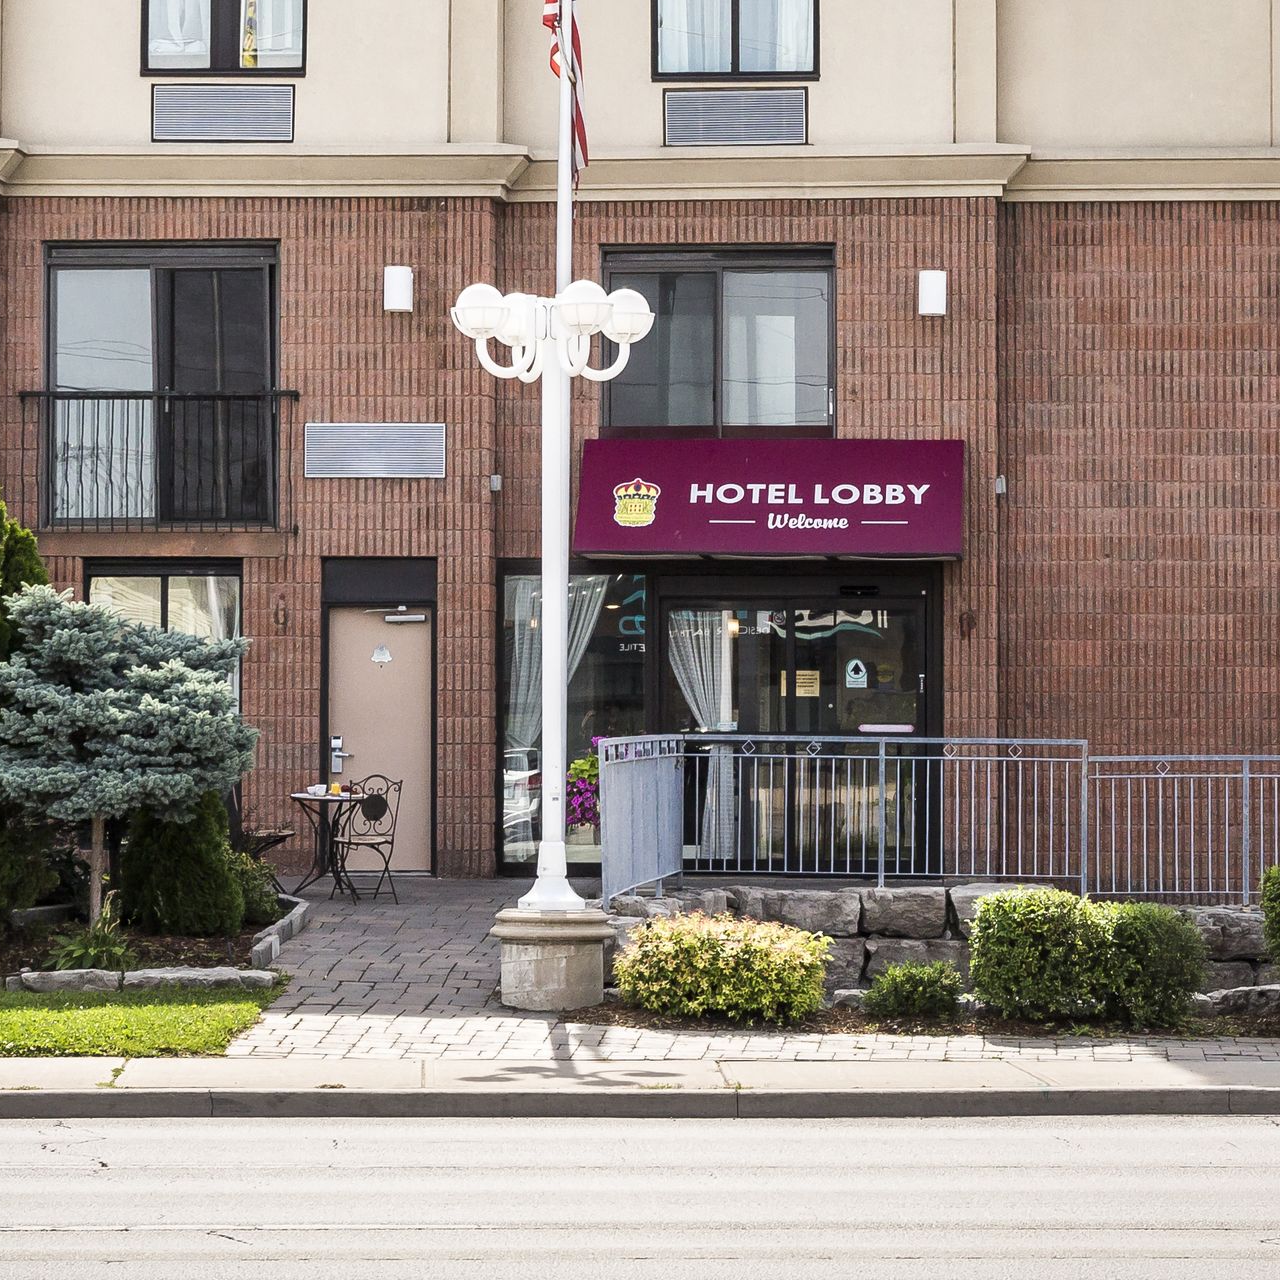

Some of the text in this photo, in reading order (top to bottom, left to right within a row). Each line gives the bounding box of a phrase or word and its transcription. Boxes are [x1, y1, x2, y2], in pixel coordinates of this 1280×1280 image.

[689, 482, 931, 505] HOTEL LOBBY
[767, 512, 850, 530] Welcome
